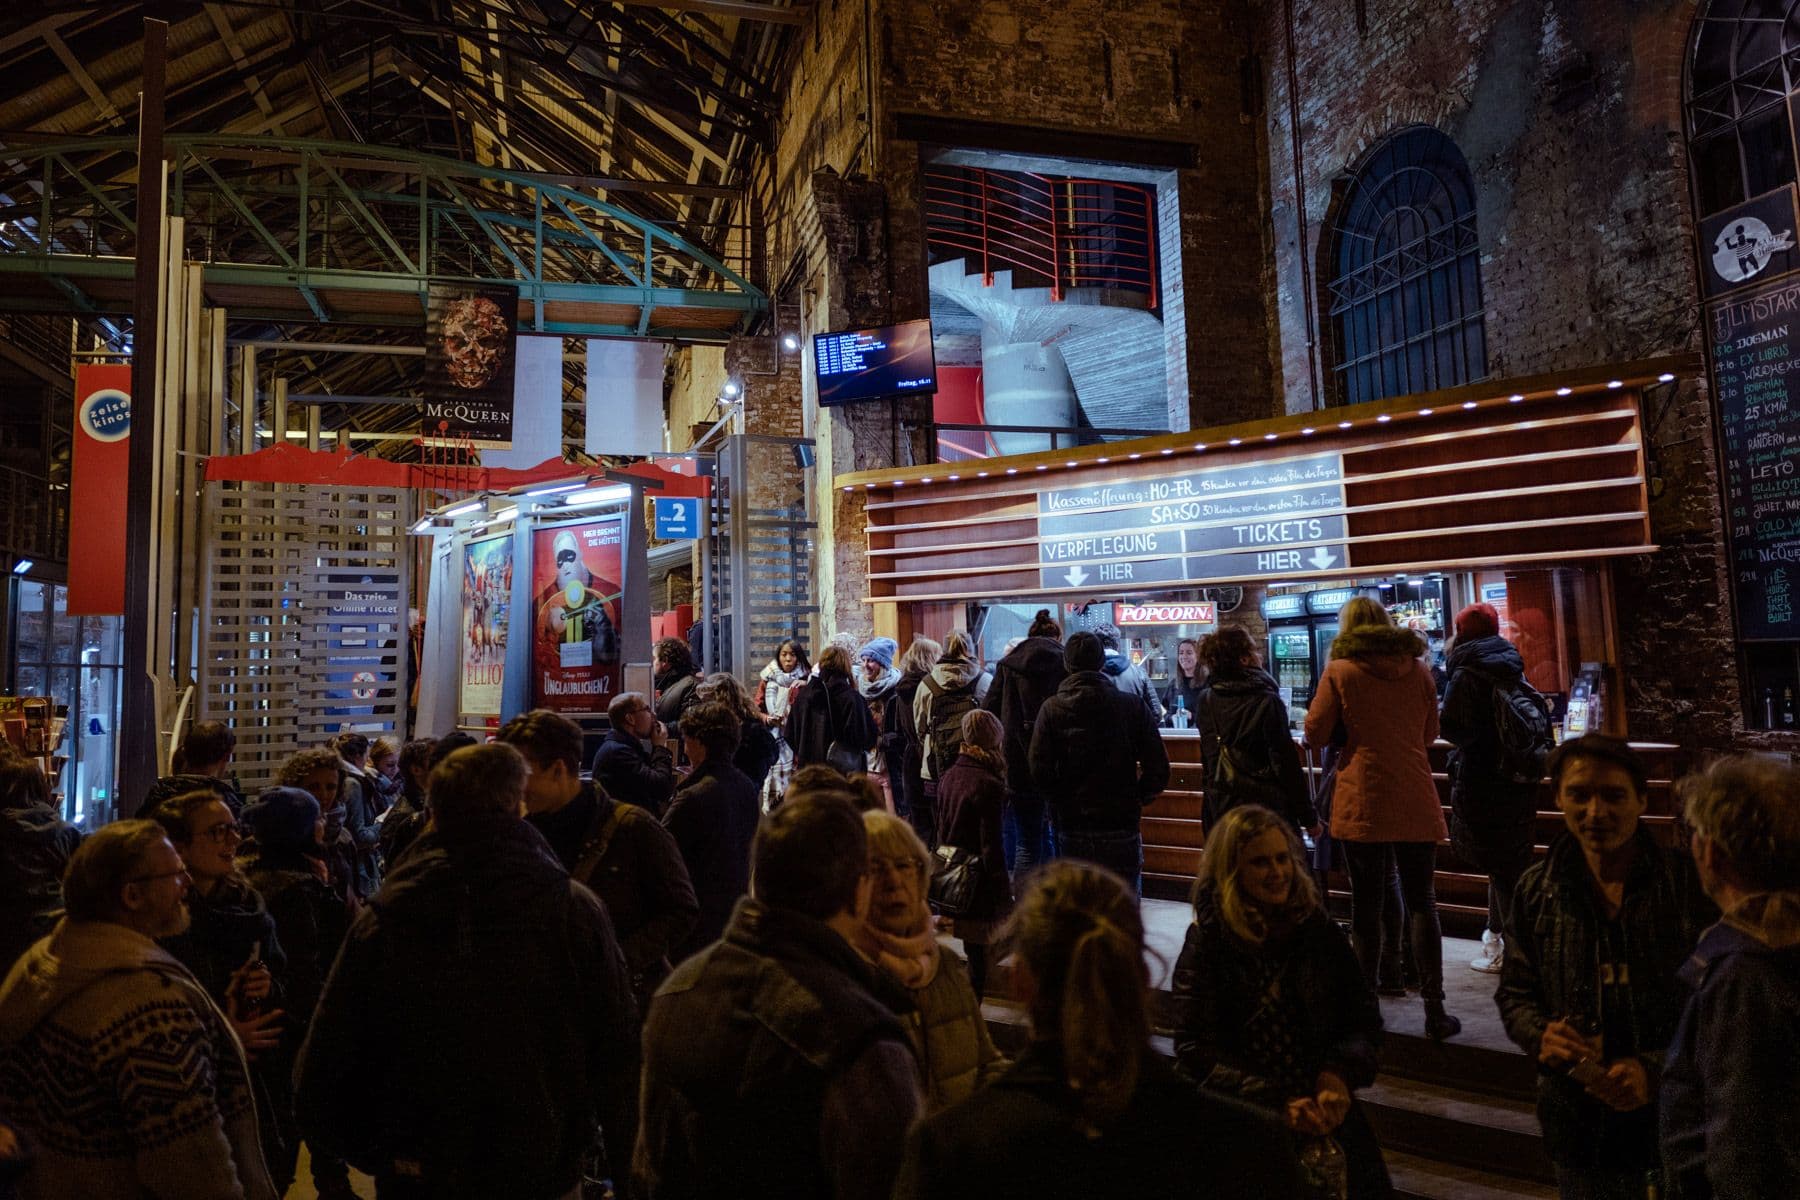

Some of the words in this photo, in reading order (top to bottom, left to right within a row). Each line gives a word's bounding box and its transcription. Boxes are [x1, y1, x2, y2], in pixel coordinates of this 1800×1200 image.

[1736, 324, 1788, 349] DOGMAN
[1740, 352, 1754, 366] EX
[1759, 344, 1789, 360] LIBRIS
[90, 401, 127, 418] zeise
[1745, 406, 1760, 420] 25
[93, 411, 131, 428] kinos
[1751, 461, 1794, 479] LETO
[1049, 488, 1148, 509] Kassenöffnung:
[672, 502, 686, 522] 2
[1232, 519, 1322, 544] TICKETS
[1755, 519, 1785, 533] COLD
[1045, 532, 1157, 559] VERPFLEGUNG
[1257, 550, 1303, 571] HIER
[1099, 562, 1134, 582] HIER
[345, 591, 362, 600] Das
[1120, 606, 1208, 621] POPCORN
[603, 675, 610, 694] 2
